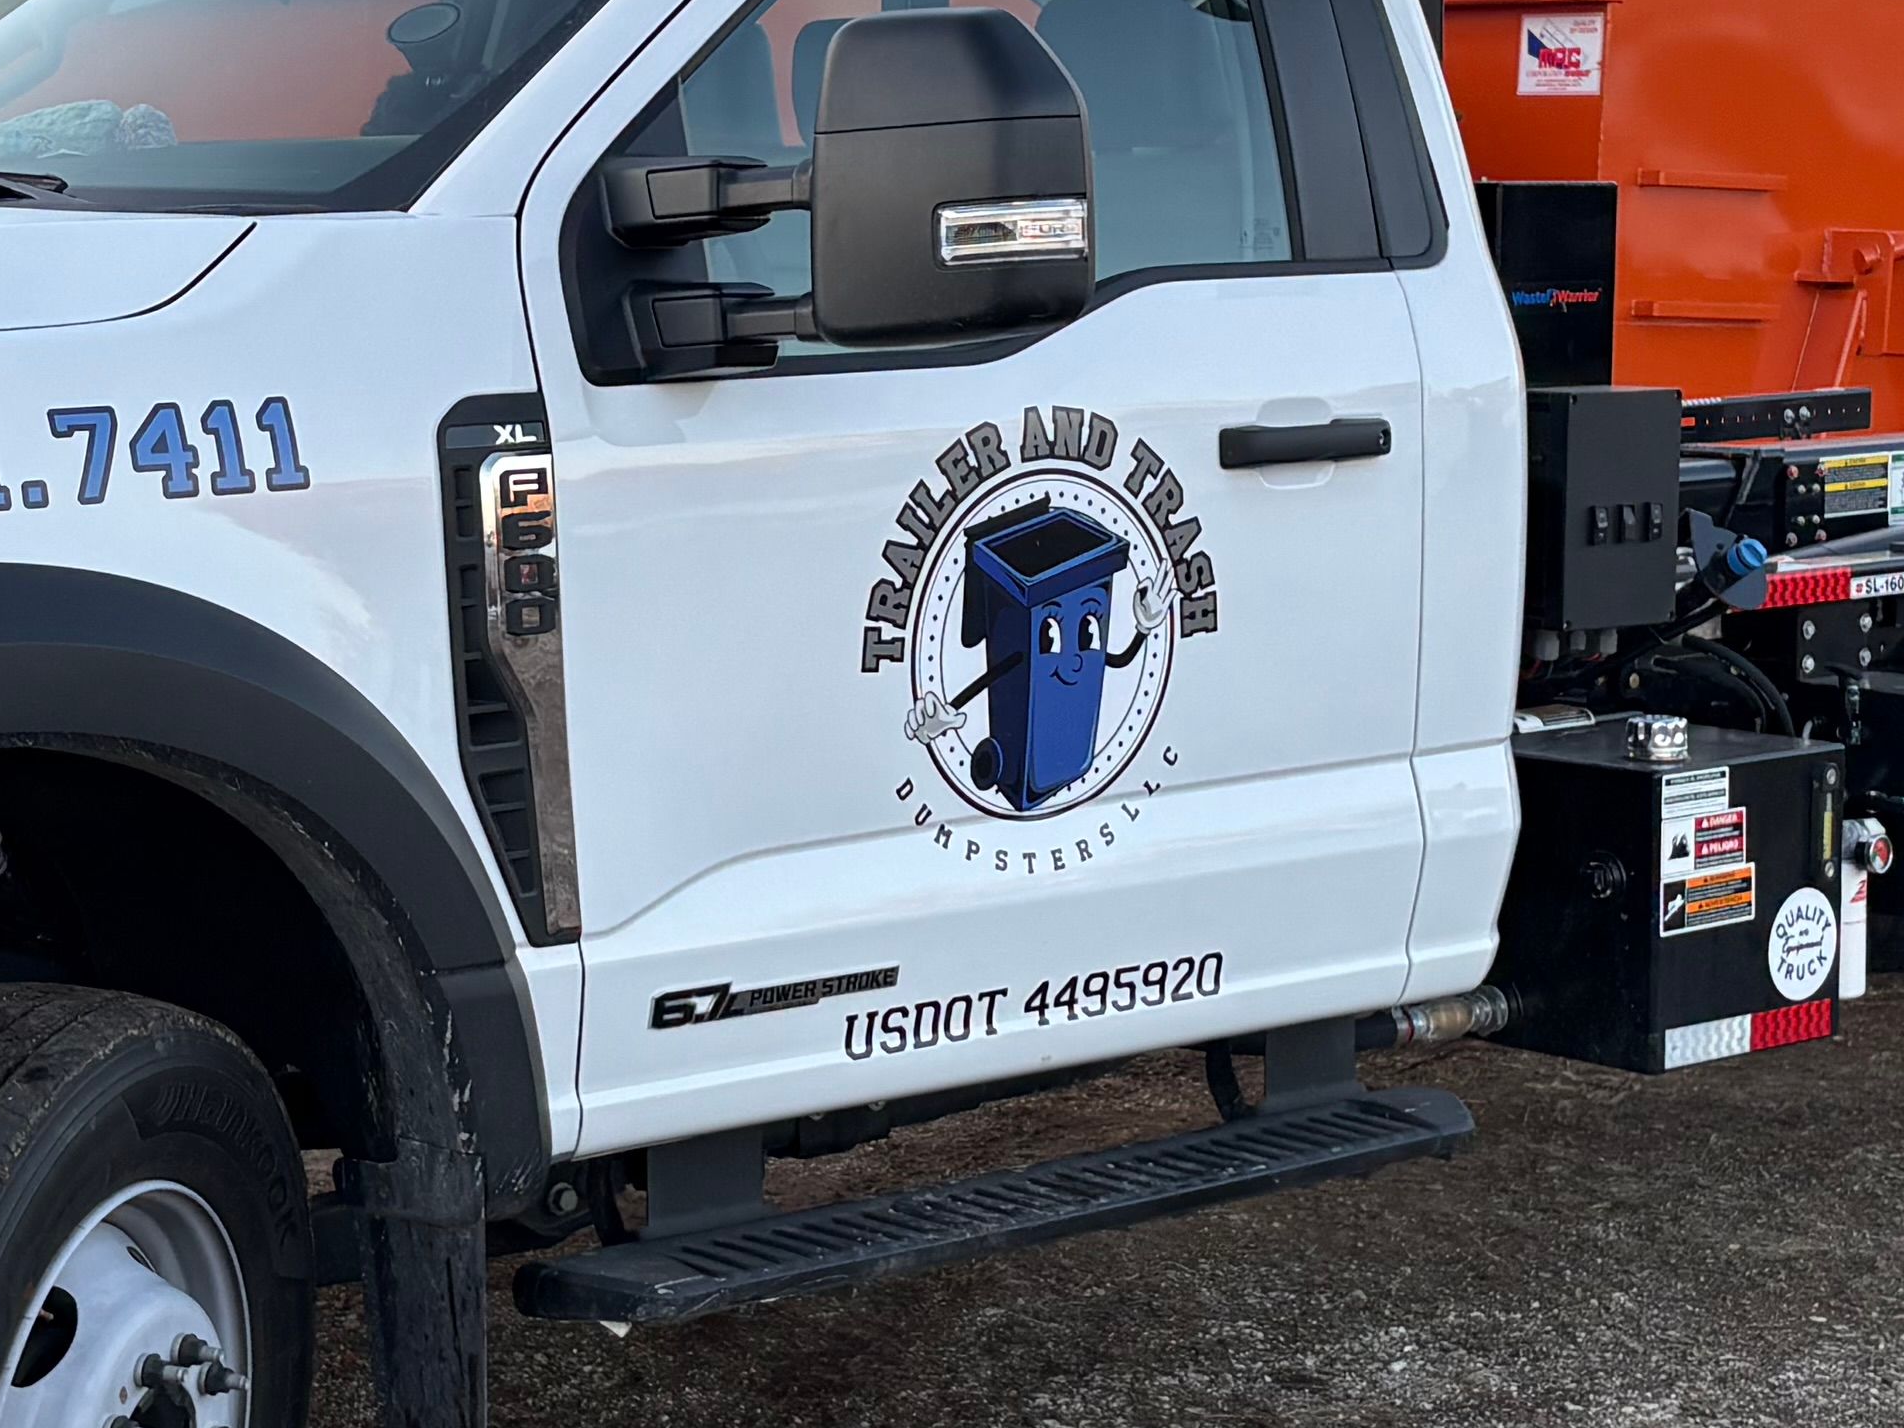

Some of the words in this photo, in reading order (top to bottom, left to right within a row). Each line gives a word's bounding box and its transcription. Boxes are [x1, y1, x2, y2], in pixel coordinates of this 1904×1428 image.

[494, 424, 537, 445] XL
[860, 420, 1012, 674] TRAILER
[1019, 404, 1119, 472] AND
[1122, 437, 1219, 639] TRASH
[1864, 574, 1904, 594] SL-160
[895, 777, 1116, 874] DUMPSTERS
[1120, 744, 1179, 822] LLC
[1775, 904, 1832, 939] QUALITY
[1777, 948, 1828, 981] TRUCK
[748, 980, 818, 1008] POWER
[821, 968, 899, 998] STROKE
[843, 986, 1008, 1062] USDOT
[1022, 951, 1224, 1027] 4495920
